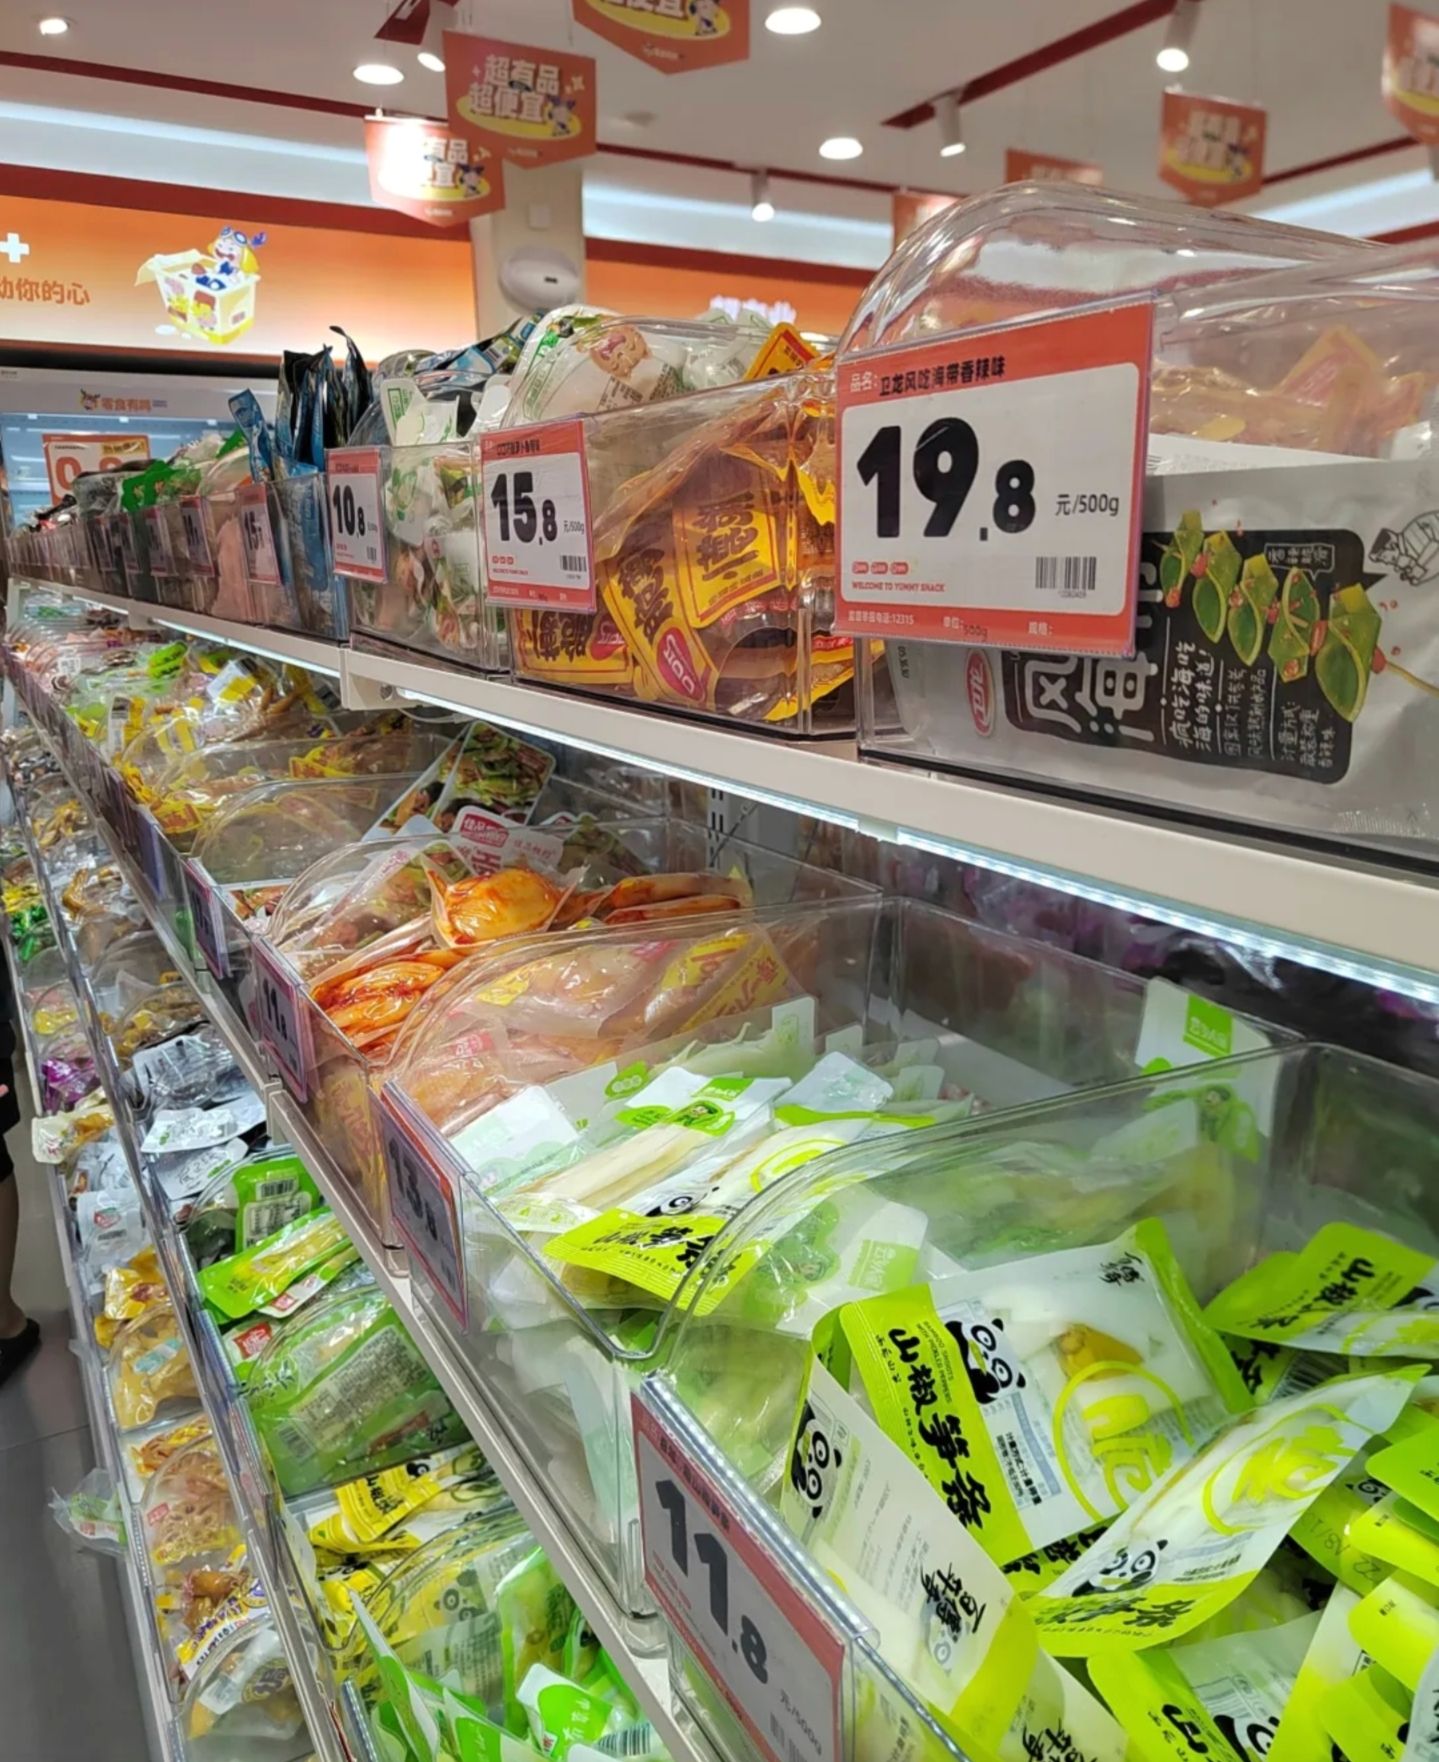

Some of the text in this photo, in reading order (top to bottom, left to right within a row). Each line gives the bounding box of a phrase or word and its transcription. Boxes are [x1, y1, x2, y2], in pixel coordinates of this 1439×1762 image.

[469, 82, 546, 123] 超便宜
[484, 54, 560, 96] 超有品
[879, 356, 1006, 396] 卫龙风吃海带香辣味
[333, 484, 365, 539] 10.8
[490, 471, 558, 546] 15.8
[857, 417, 1035, 542] 19.8
[1055, 494, 1120, 516] 元/500g
[852, 581, 883, 591] WELCOME
[885, 582, 893, 591] TO
[895, 582, 919, 592] YUMMY
[1170, 641, 1197, 749] 疯吃海吃
[1192, 649, 1215, 753] 海的味道!
[888, 1328, 993, 1530] 山椒笋条
[655, 1479, 769, 1684] 11.8
